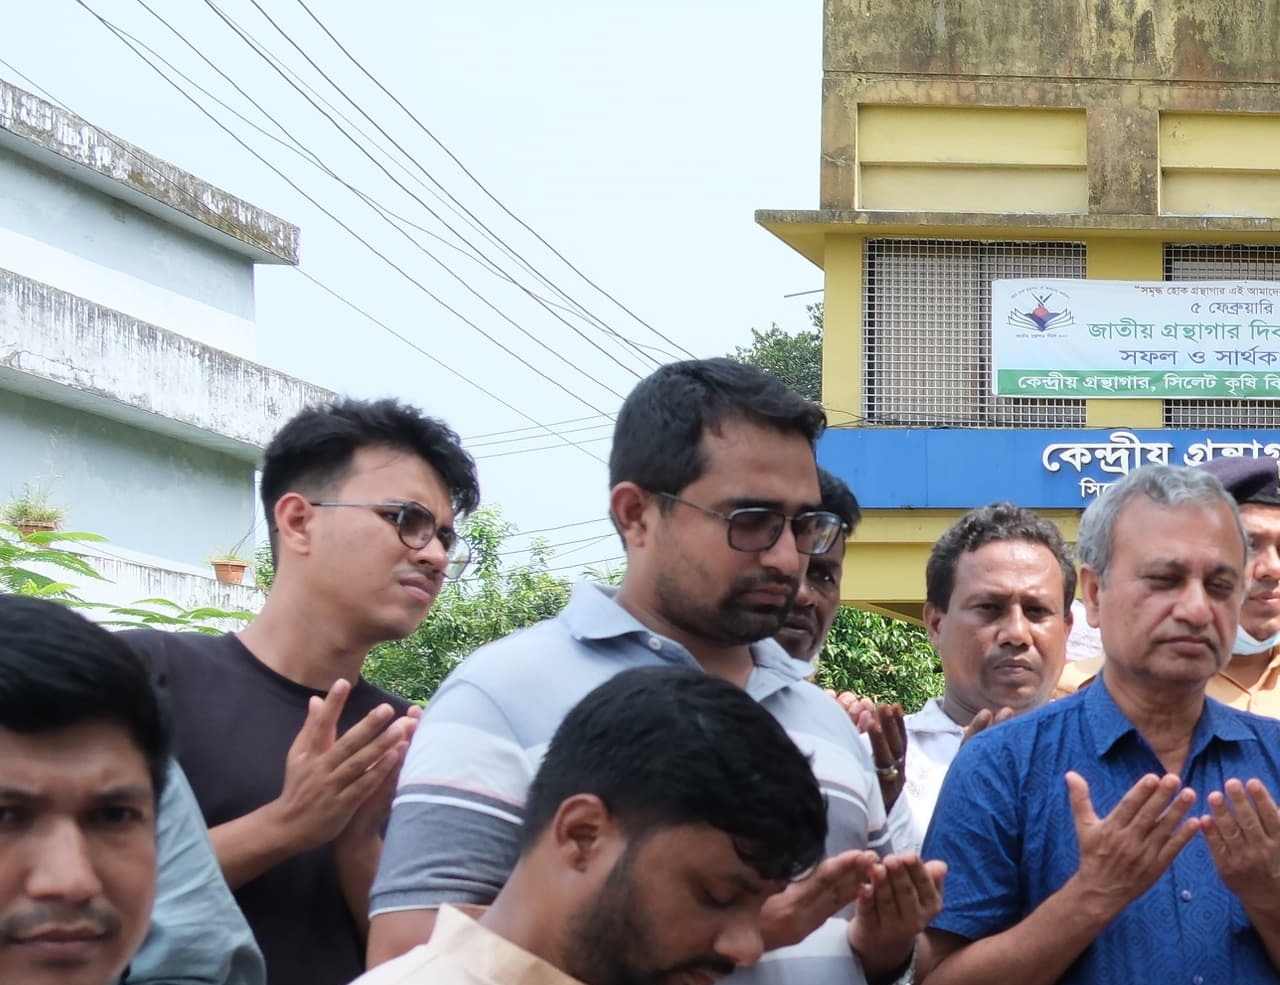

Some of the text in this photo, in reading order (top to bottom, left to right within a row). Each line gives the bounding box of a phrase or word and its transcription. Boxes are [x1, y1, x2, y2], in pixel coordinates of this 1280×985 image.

[1166, 286, 1189, 296] হোক
[1191, 286, 1225, 297] গ্রন্থাগার
[1228, 285, 1245, 297] এই
[1190, 298, 1274, 315] ৫ ফেব্রুয়ারি
[1087, 317, 1155, 340] জাতীয়
[1161, 320, 1242, 344] গ্রন্থাগার
[1119, 350, 1179, 366] সফল
[1188, 351, 1206, 365] ও
[1215, 345, 1280, 367] সার্থক
[1018, 371, 1079, 392] কেন্দ্রীয়
[1082, 375, 1157, 393] গ্রন্থাগার,
[1163, 372, 1218, 390] সিলেট
[1224, 373, 1258, 396] কৃষি
